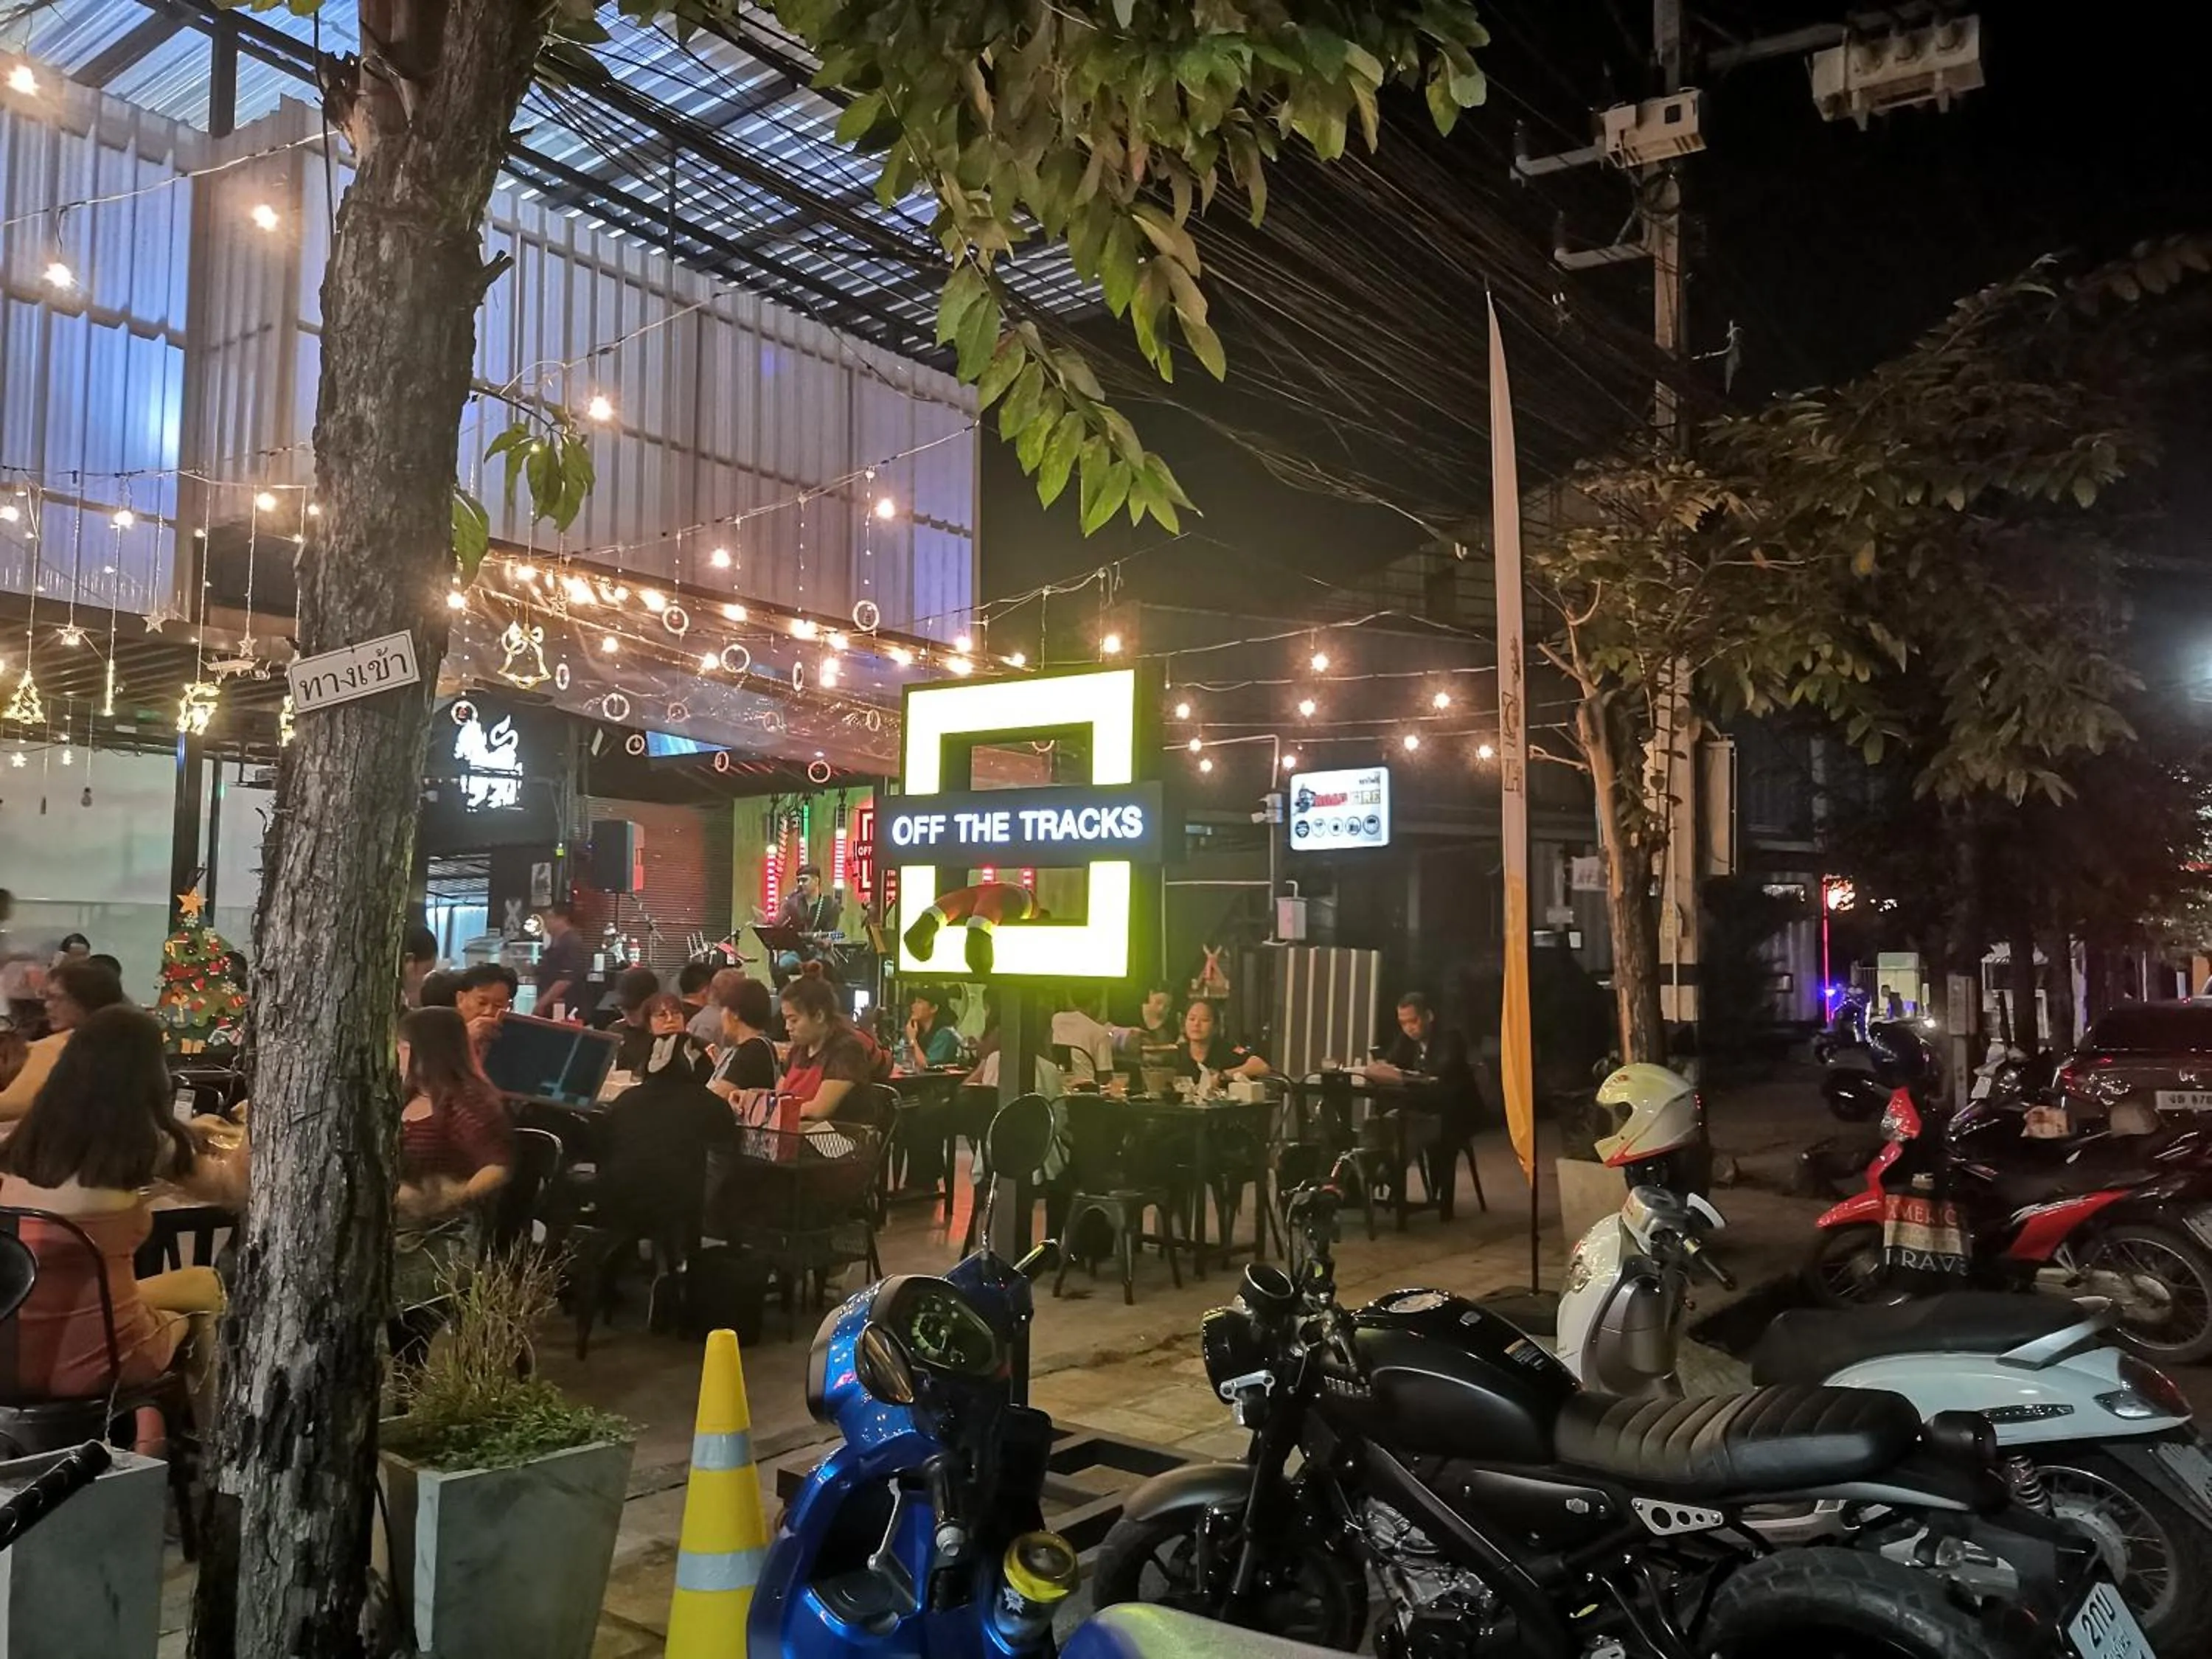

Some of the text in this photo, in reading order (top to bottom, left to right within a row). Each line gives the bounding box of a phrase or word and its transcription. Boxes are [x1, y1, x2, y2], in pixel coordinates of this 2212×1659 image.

[299, 647, 408, 700] ทางเข้า
[891, 805, 1144, 846] OFF THE TRACKS
[858, 846, 872, 856] OFF
